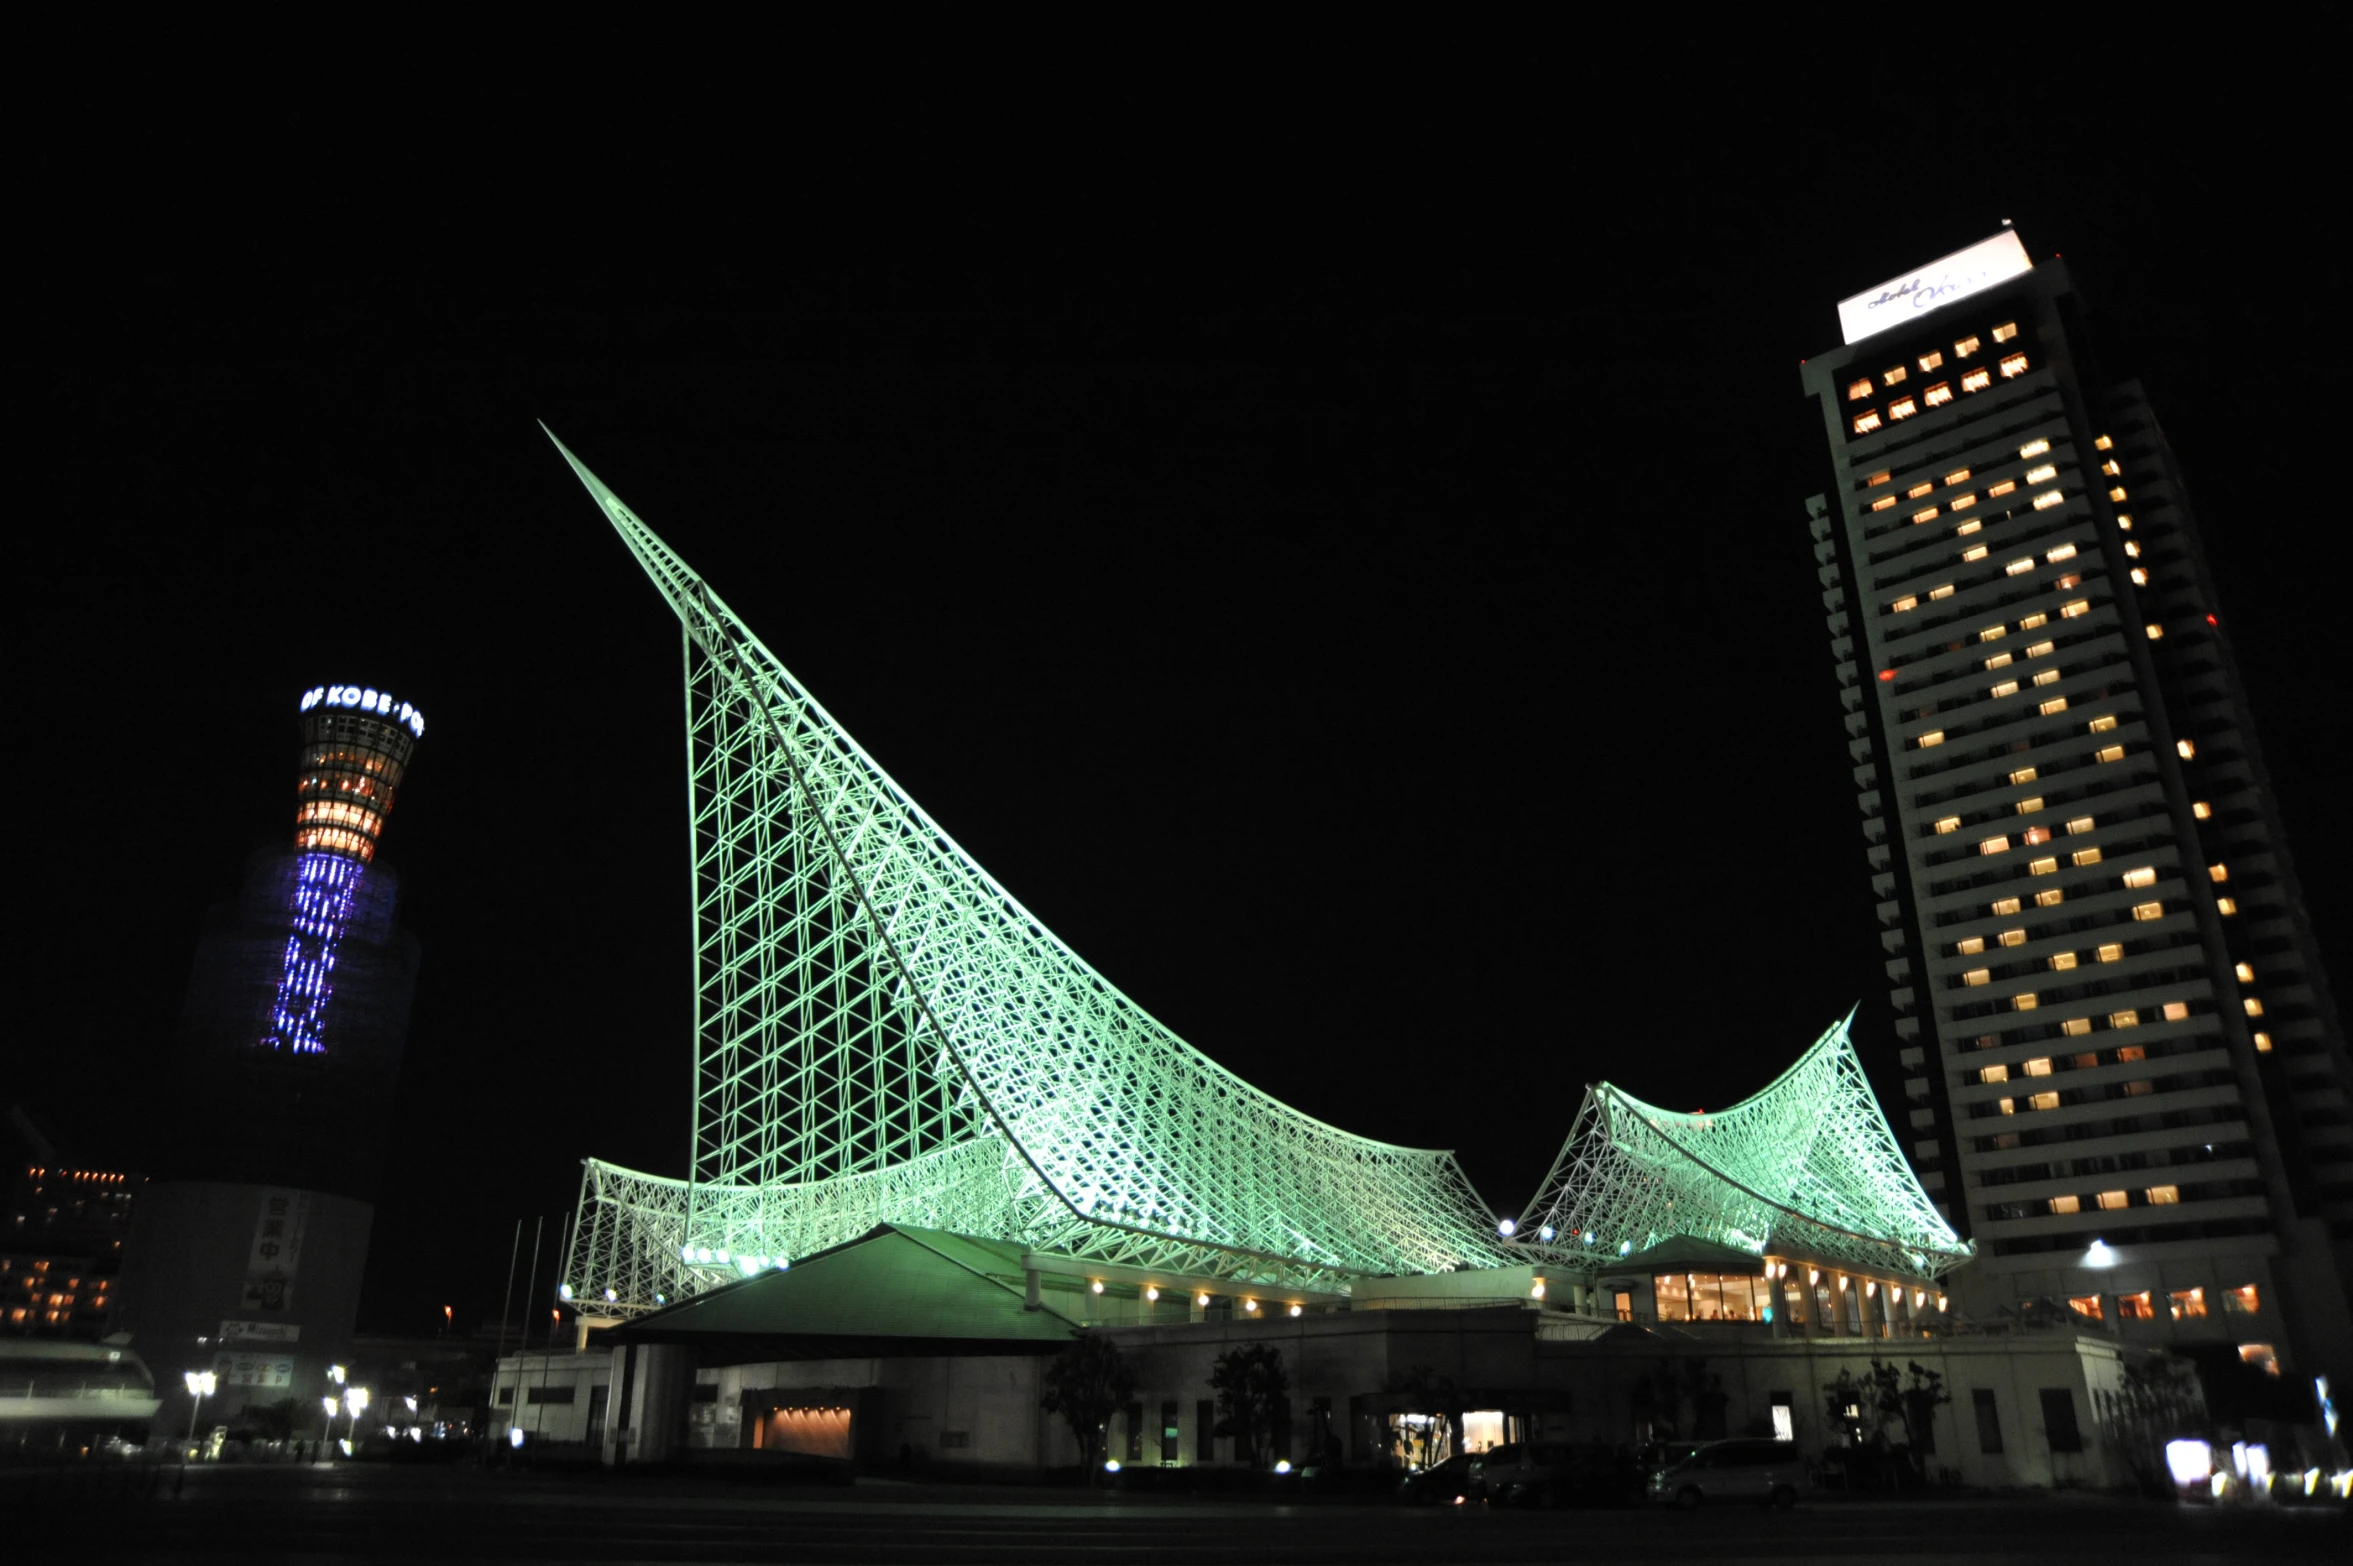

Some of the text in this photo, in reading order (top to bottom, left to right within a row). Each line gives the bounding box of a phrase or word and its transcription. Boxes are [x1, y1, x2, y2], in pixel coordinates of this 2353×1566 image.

[301, 686, 324, 712] OF
[326, 685, 392, 715] KOBE
[259, 1196, 289, 1261] 営業中
